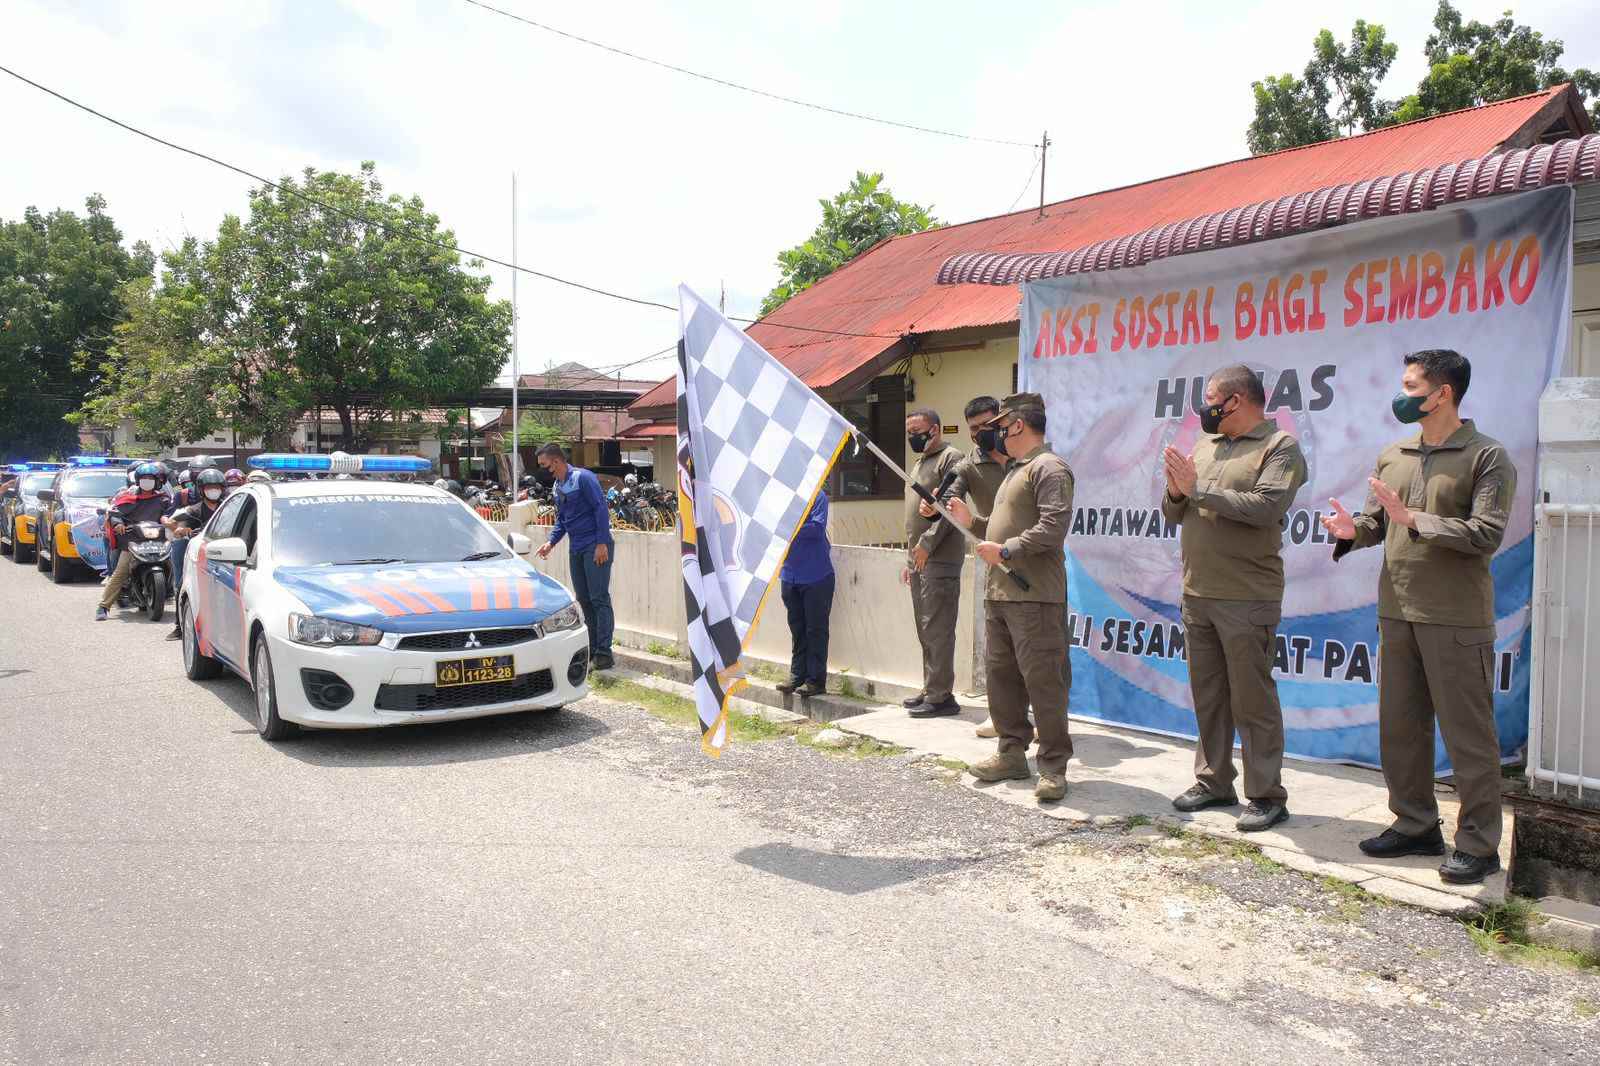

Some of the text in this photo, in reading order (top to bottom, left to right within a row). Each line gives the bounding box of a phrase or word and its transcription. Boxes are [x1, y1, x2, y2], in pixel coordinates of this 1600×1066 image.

[1032, 234, 1543, 359] AKSI SOSIAL BAGI SEMBAKO
[1070, 507, 1178, 539] ARTAWAN
[1100, 617, 1188, 661] SESAM
[466, 667, 512, 682] 1123-28
